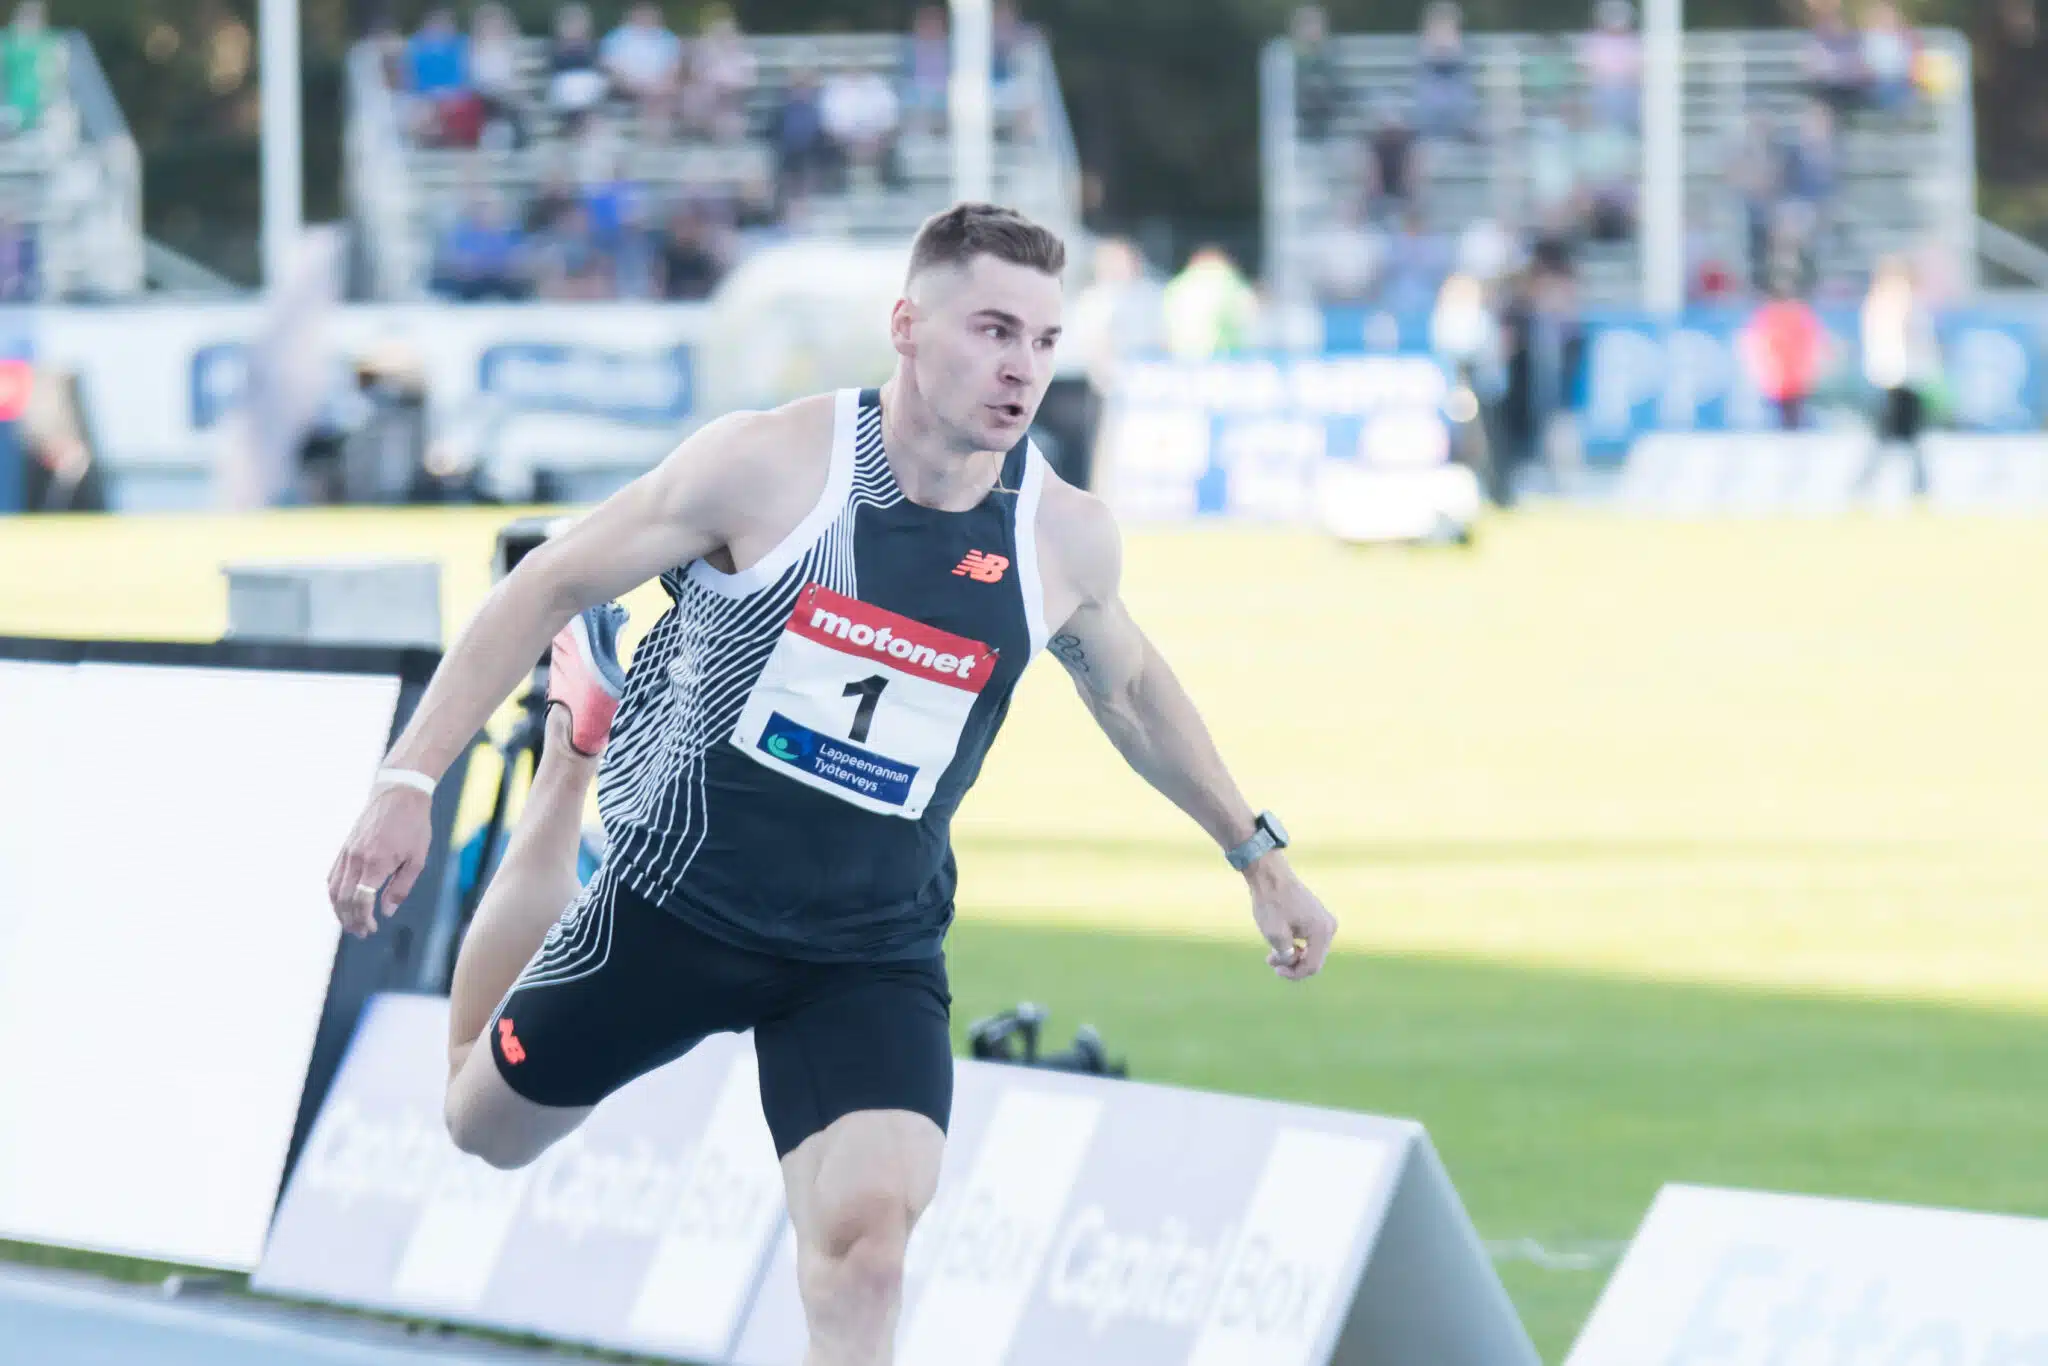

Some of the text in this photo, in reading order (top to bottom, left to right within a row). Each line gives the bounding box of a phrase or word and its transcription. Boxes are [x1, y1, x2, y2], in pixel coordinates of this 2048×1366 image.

[810, 607, 976, 680] motonet
[842, 674, 889, 744] 1
[814, 757, 879, 793] Työterveys
[819, 743, 909, 784] Lappeenrannan
